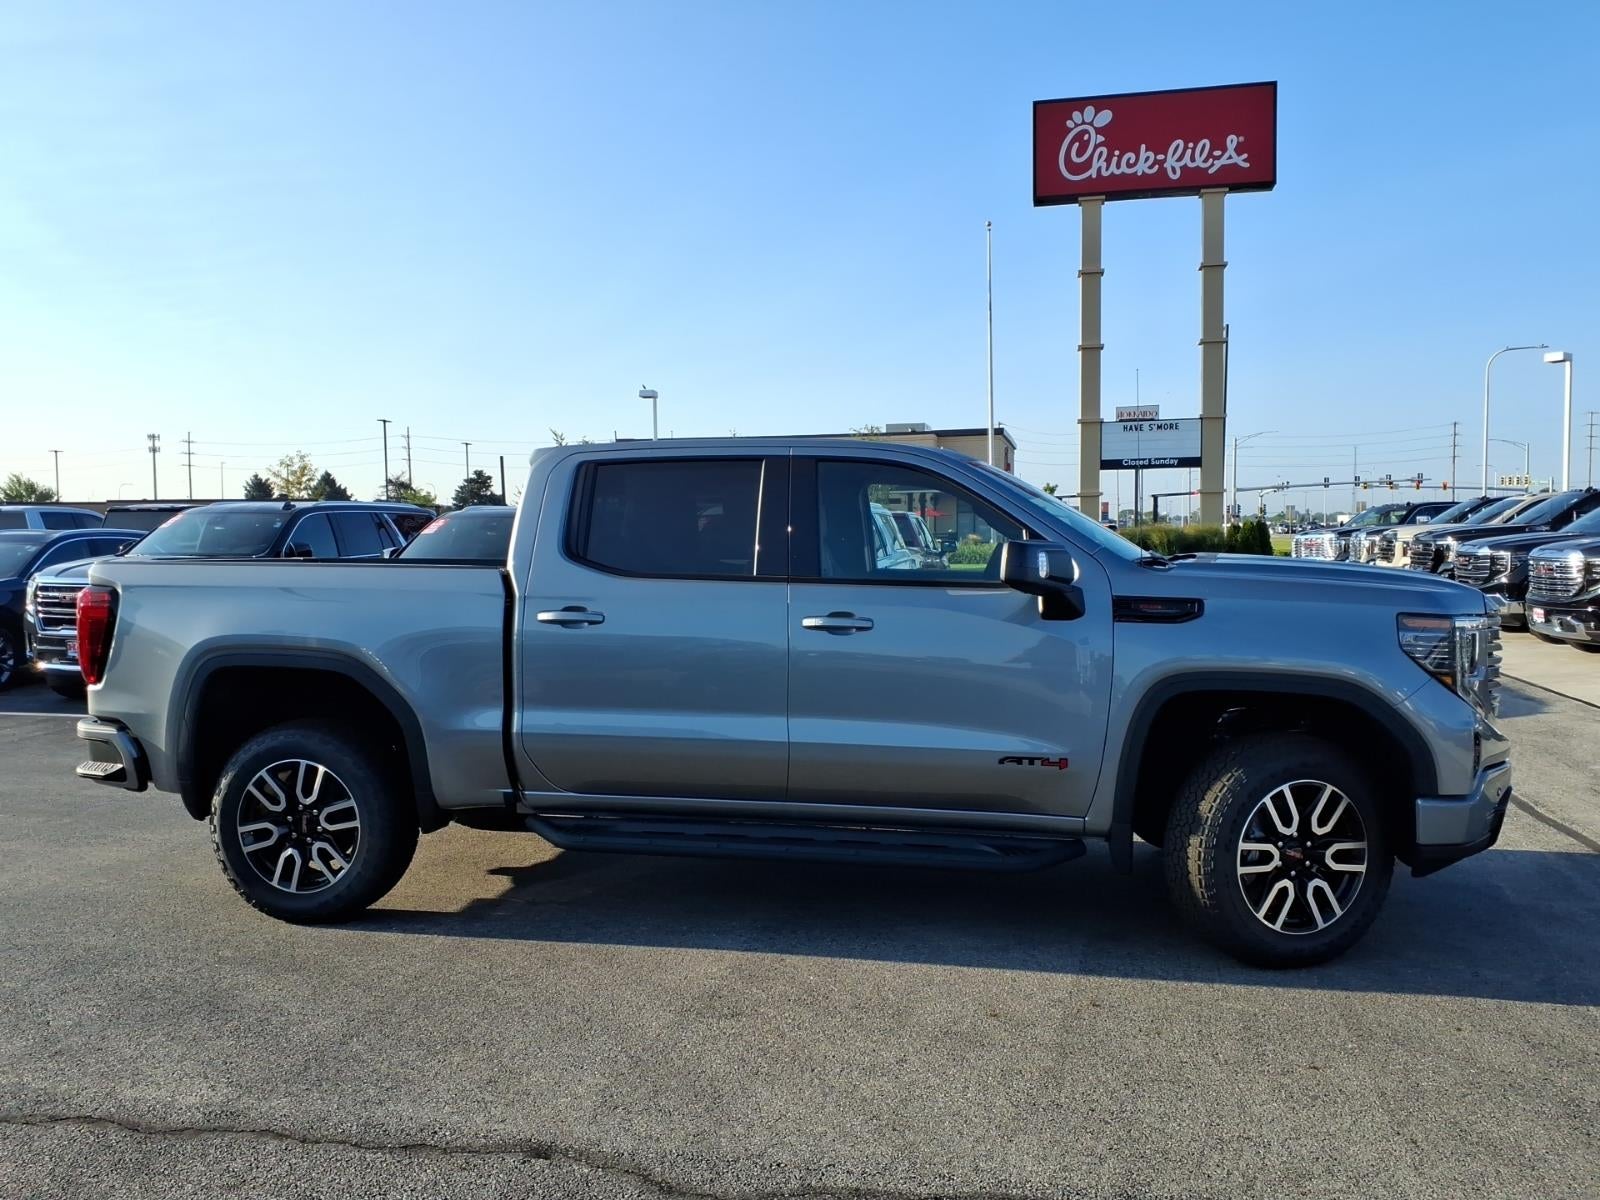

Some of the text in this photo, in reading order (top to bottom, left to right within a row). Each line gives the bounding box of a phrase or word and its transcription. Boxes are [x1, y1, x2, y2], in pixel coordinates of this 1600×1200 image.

[1058, 123, 1250, 181] Chick-fil-A
[1123, 423, 1180, 432] HAVE S'MORE
[1150, 458, 1179, 466] Sunday
[998, 755, 1068, 770] AT4
